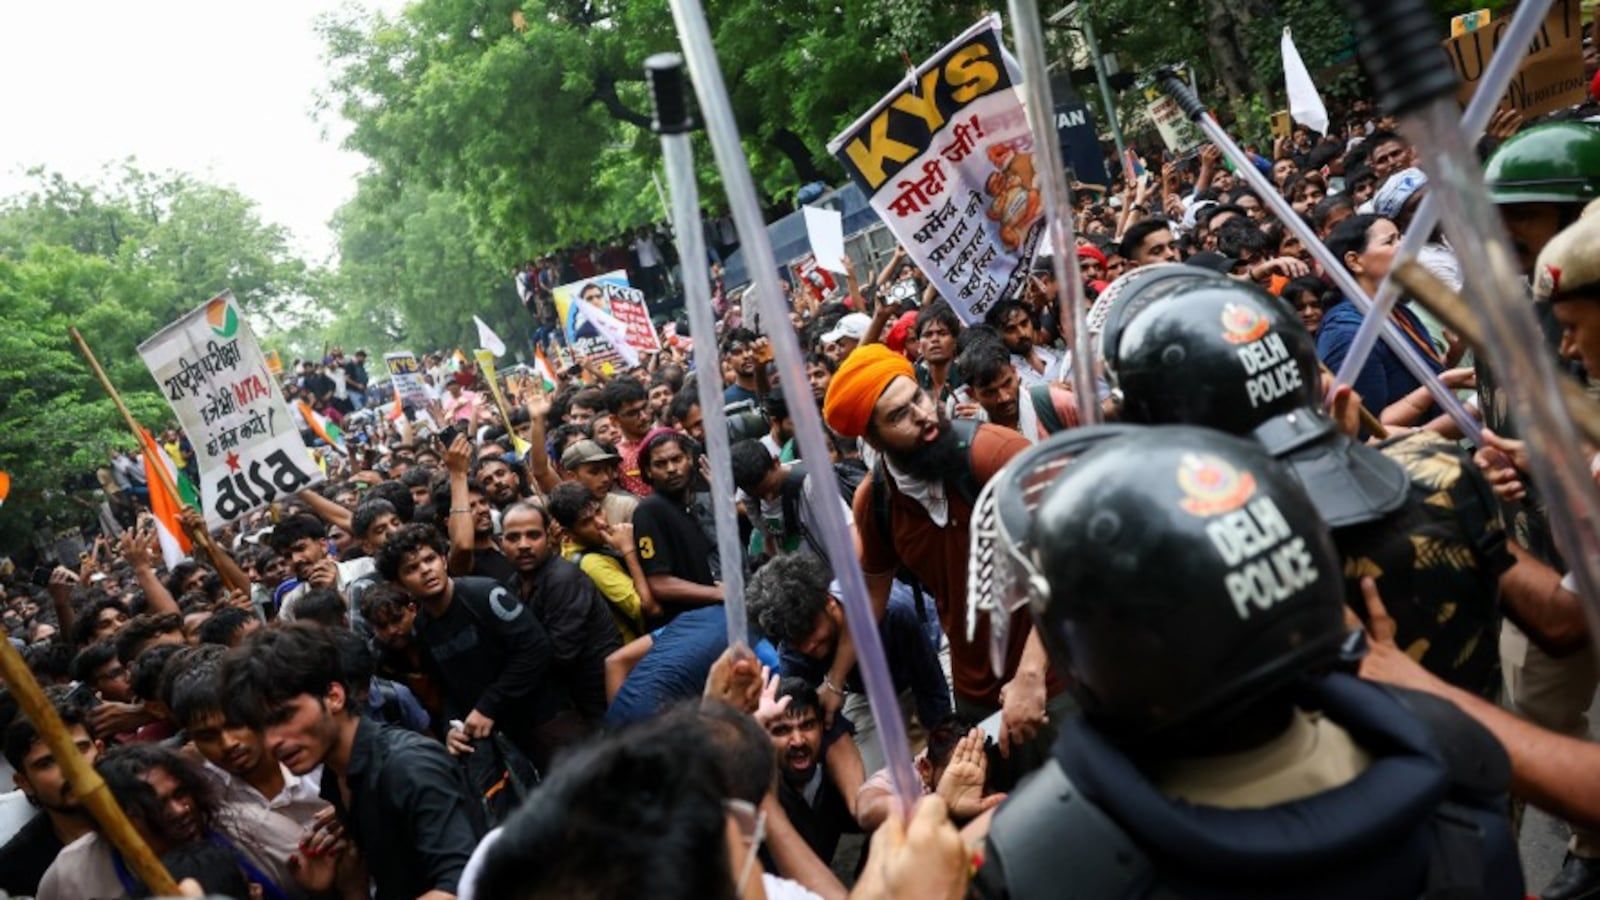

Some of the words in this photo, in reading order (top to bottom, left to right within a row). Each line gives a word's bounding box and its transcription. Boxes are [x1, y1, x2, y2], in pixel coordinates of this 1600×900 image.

[845, 43, 999, 190] KYS
[887, 160, 947, 217] मोदी
[940, 114, 984, 162] जी!
[913, 196, 959, 243] धर्मेन्द्र
[928, 218, 968, 267] प्रधान
[965, 190, 983, 218] को
[943, 223, 986, 284] तत्काल
[969, 275, 1000, 316] करो!
[164, 357, 207, 400] राष्ट्रीय
[200, 339, 241, 377] परीक्षा
[1237, 332, 1290, 375] DELHI
[1245, 359, 1303, 408] POLICE
[215, 448, 311, 520] aisa
[639, 536, 656, 559] 3
[1205, 495, 1292, 566] DELHI
[1224, 537, 1319, 620] POLICE
